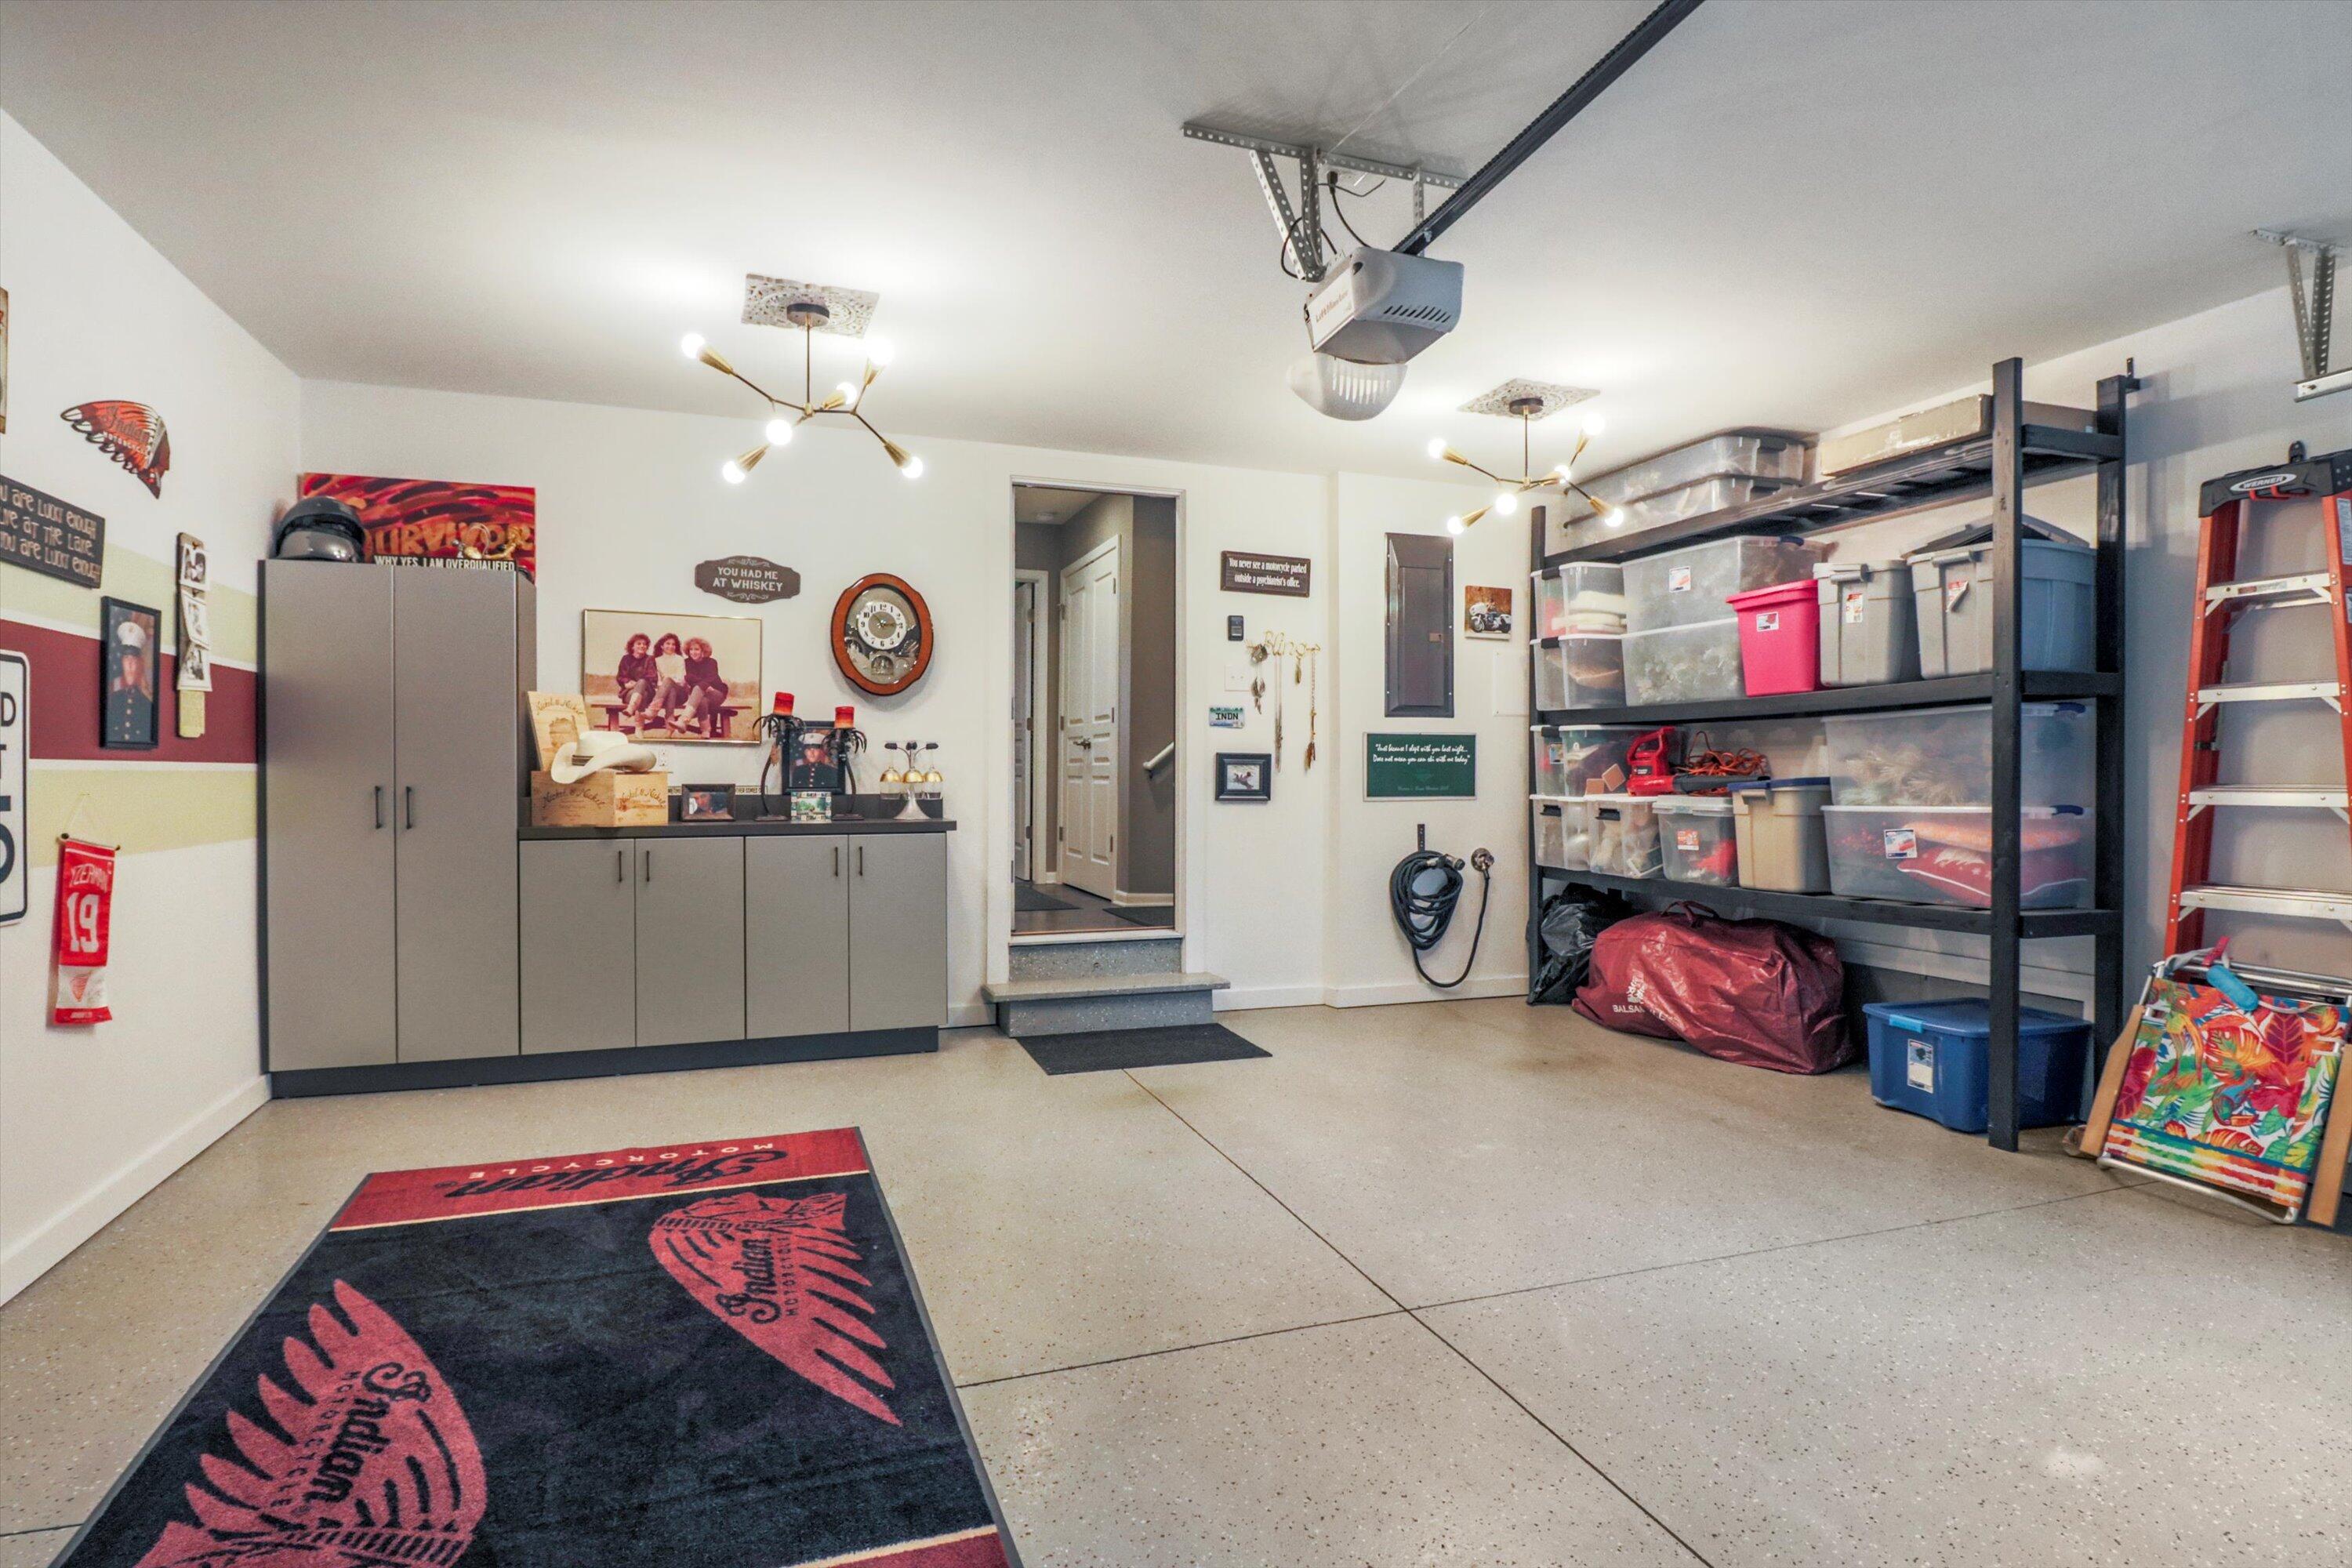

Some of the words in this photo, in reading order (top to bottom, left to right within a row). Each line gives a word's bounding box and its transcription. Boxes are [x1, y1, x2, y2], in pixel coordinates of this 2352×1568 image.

[2243, 476, 2284, 489] WERNER
[375, 554, 398, 566] WHY
[429, 560, 444, 569] AM
[445, 560, 515, 572] OVERQUALIFIED
[1229, 557, 1238, 568] You
[1239, 559, 1252, 568] never
[1252, 561, 1261, 570] see
[1265, 562, 1290, 574] motorcycle
[1290, 563, 1307, 575] parked
[717, 567, 739, 577] YOU
[740, 569, 762, 579] HAD
[764, 571, 779, 580] ME
[1234, 573, 1252, 583] outside
[713, 578, 728, 587] AT
[731, 578, 783, 592] WHISKEY
[1215, 712, 1239, 720] INDN
[1388, 744, 1405, 753] because
[1420, 744, 1432, 753] with
[1432, 746, 1441, 755] you
[1441, 744, 1451, 753] last
[1373, 754, 1384, 763] Does
[1407, 757, 1417, 765] you
[1436, 754, 1446, 763] with
[67, 891, 100, 953] 19
[469, 1142, 774, 1179] MOTORCYCLE
[715, 1238, 782, 1324] Indian
[303, 1361, 433, 1503] Indian
